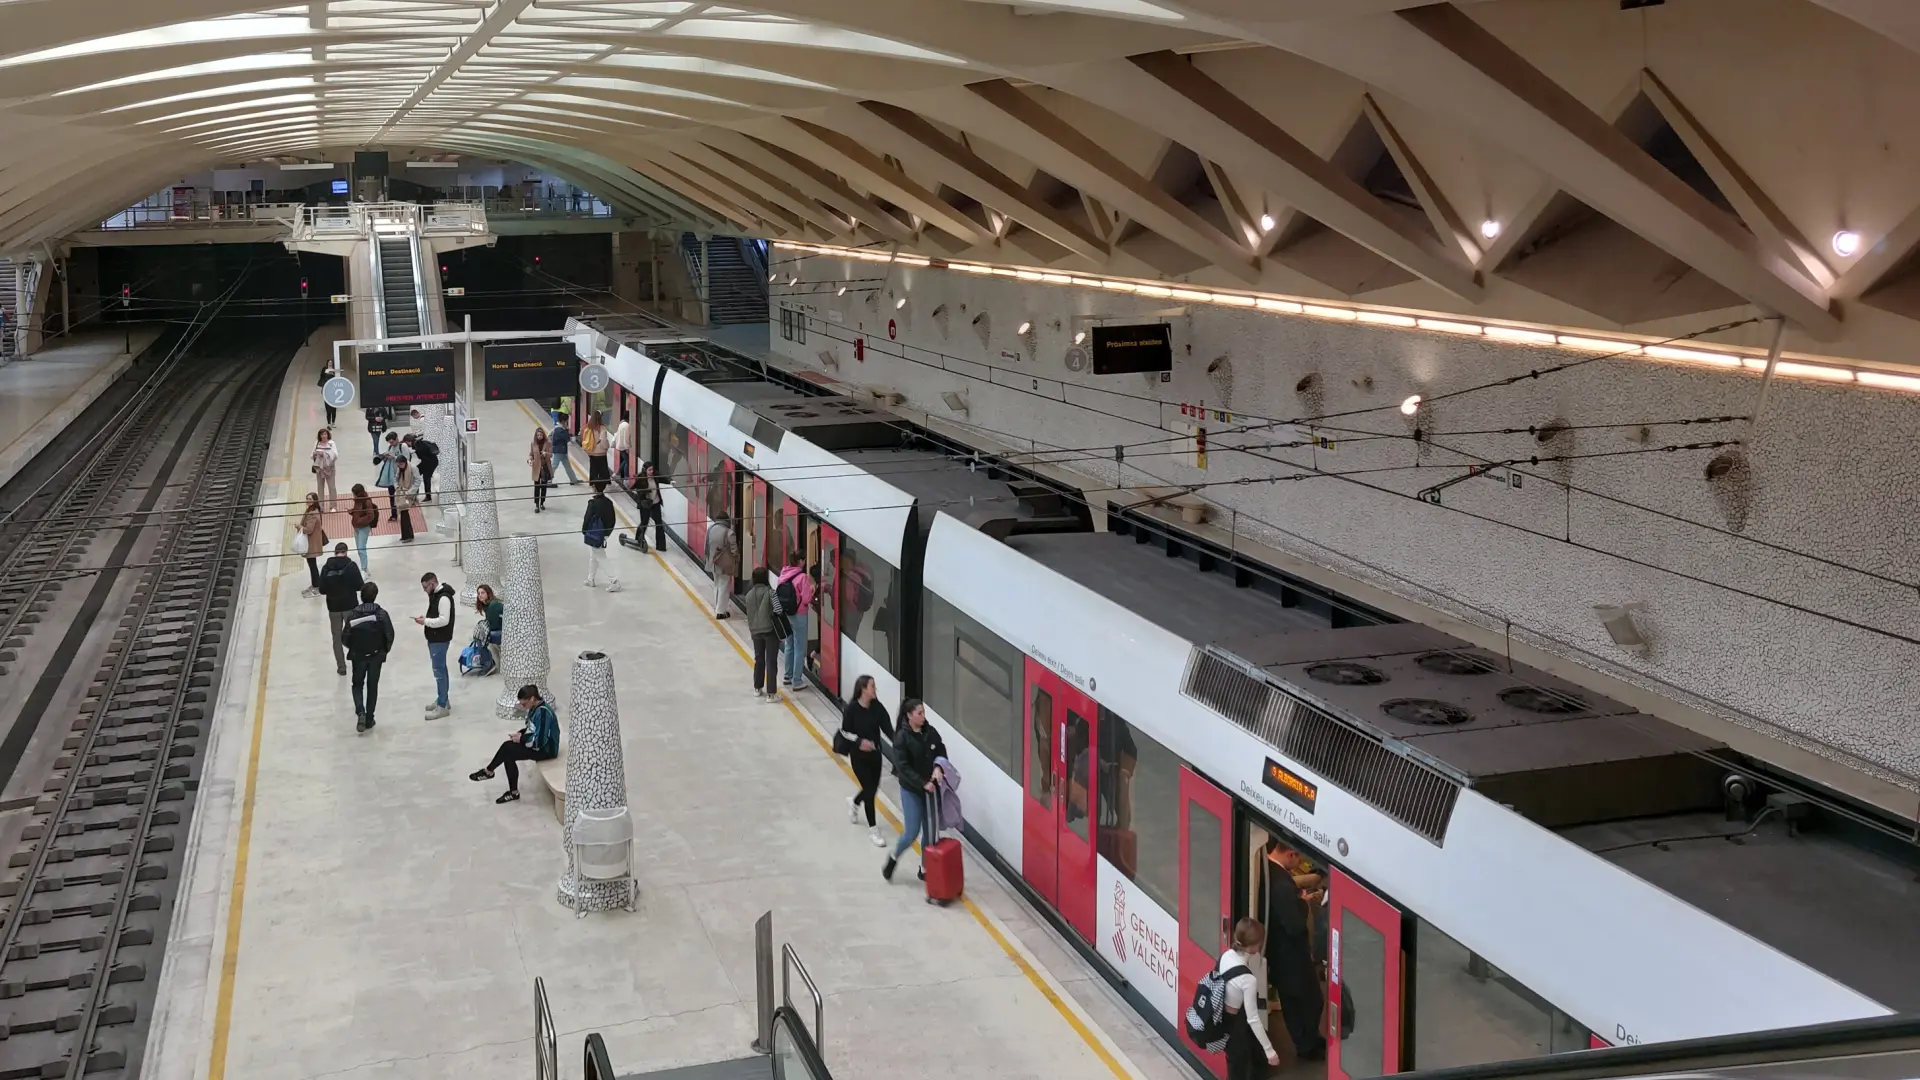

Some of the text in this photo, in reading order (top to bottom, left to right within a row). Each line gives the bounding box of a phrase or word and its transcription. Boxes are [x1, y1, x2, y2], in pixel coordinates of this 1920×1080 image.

[390, 367, 421, 375] Destinació
[1072, 357, 1080, 369] 4
[590, 374, 600, 389] 3
[334, 388, 345, 404] 2
[1240, 780, 1265, 805] Deixeu
[1266, 799, 1283, 817] eixir
[1289, 812, 1312, 836] Dejen
[1313, 830, 1331, 848] salir
[1130, 912, 1179, 969] GENERAL
[1131, 935, 1177, 993] VALENCI
[1616, 1023, 1645, 1046] Dei
